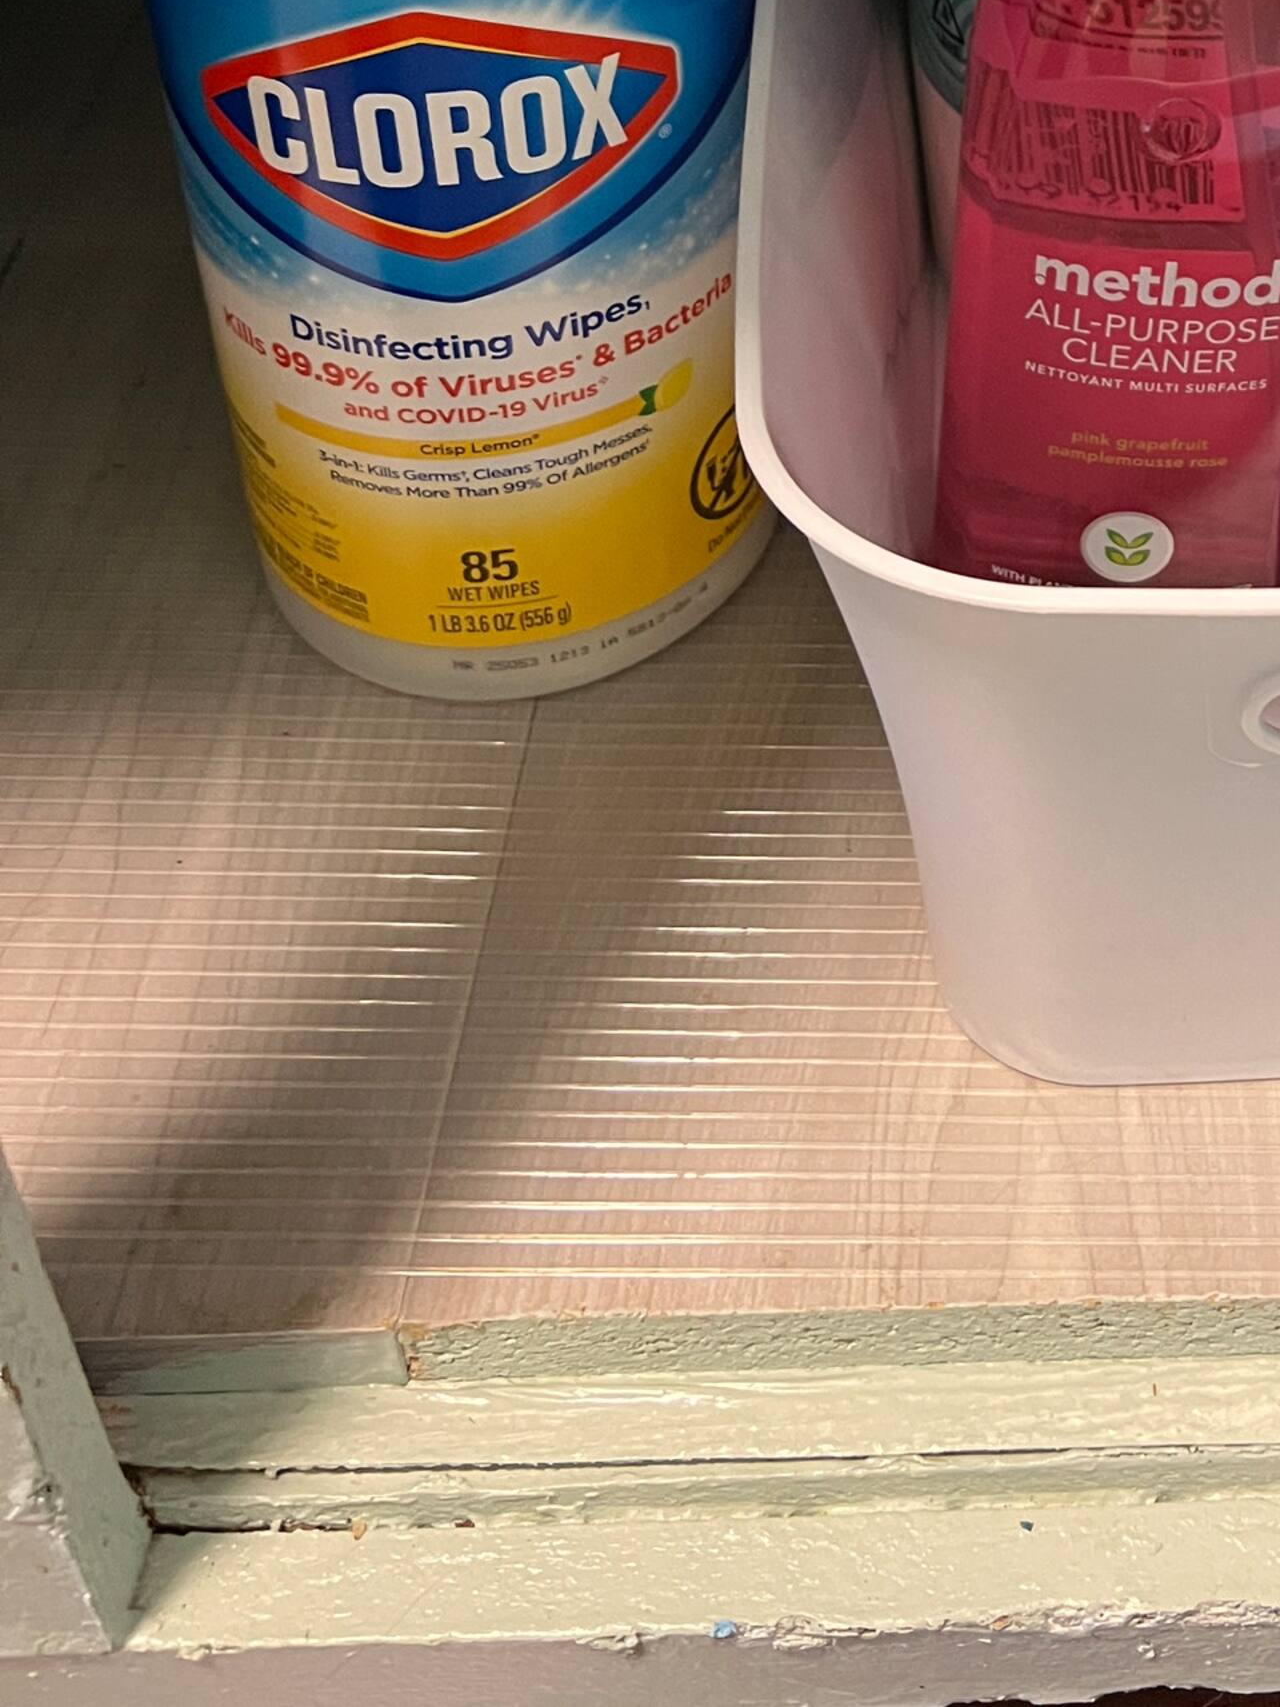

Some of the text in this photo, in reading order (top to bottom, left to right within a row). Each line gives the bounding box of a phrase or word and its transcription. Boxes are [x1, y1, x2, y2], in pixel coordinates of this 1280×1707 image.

[246, 51, 629, 189] CLOROX
[222, 305, 267, 356] Kills
[271, 342, 379, 395] 99.9%
[391, 375, 427, 398] of
[592, 342, 616, 367] &
[623, 273, 733, 356] Bacteria
[289, 313, 514, 361] Disinfecting
[1024, 298, 1280, 345] ALL-PURPOSE
[1062, 337, 1238, 374] CLEANER
[1024, 359, 1268, 395] NETTOYANT MULTI SURFACES
[343, 401, 390, 422] and
[397, 401, 526, 425] COVID-19
[420, 443, 466, 457] Crisp
[1047, 444, 1229, 469] pamplemousse rose
[1071, 429, 1209, 454] pink grapefruit
[367, 463, 400, 480] Kills
[473, 462, 533, 481] Cleans
[534, 447, 589, 471] Tough
[330, 469, 403, 496] Removes
[406, 485, 451, 499] More
[454, 485, 499, 498] Than
[502, 477, 543, 494] 99%
[546, 470, 569, 485] Of
[460, 548, 519, 583] 85
[991, 563, 1026, 583] WITH
[447, 580, 541, 602] WET WIPES
[428, 601, 573, 633] 1 LB 3.6 OZ (556 g)
